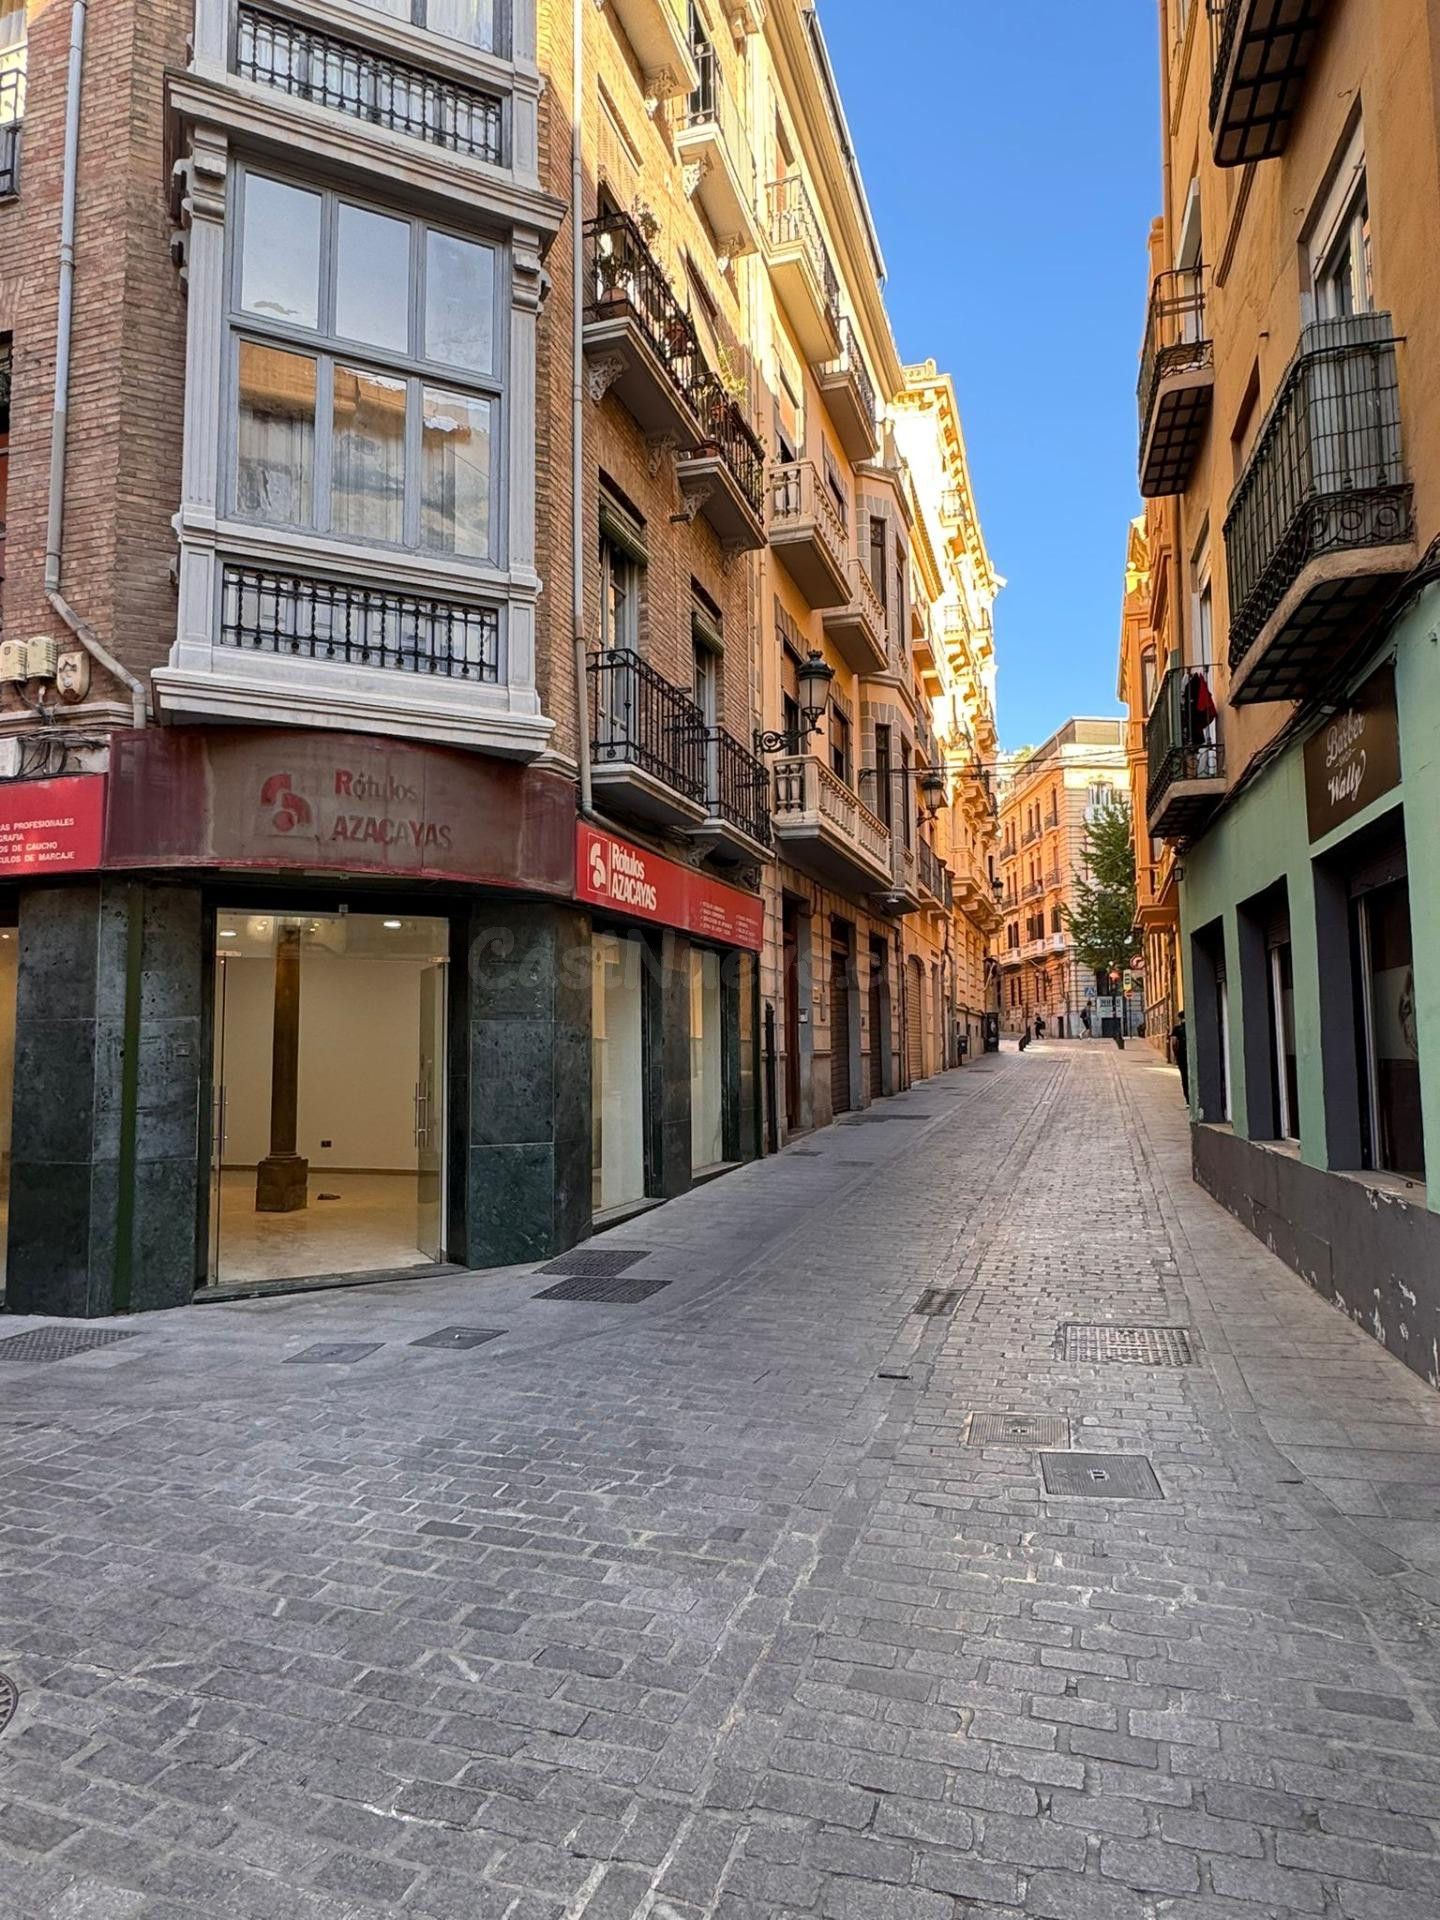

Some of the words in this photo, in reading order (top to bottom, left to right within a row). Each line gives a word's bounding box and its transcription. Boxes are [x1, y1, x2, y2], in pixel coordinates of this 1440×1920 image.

[1327, 749, 1366, 806] Wally
[13, 818, 75, 831] PROFESIONALES
[331, 815, 454, 849] AZACAYAS
[12, 844, 23, 853] DE
[26, 841, 58, 852] CAUCHO
[24, 853, 36, 863] DE
[38, 851, 76, 862] MARCAJE
[611, 842, 645, 880] Rótulos
[611, 872, 657, 911] AZACAYAS
